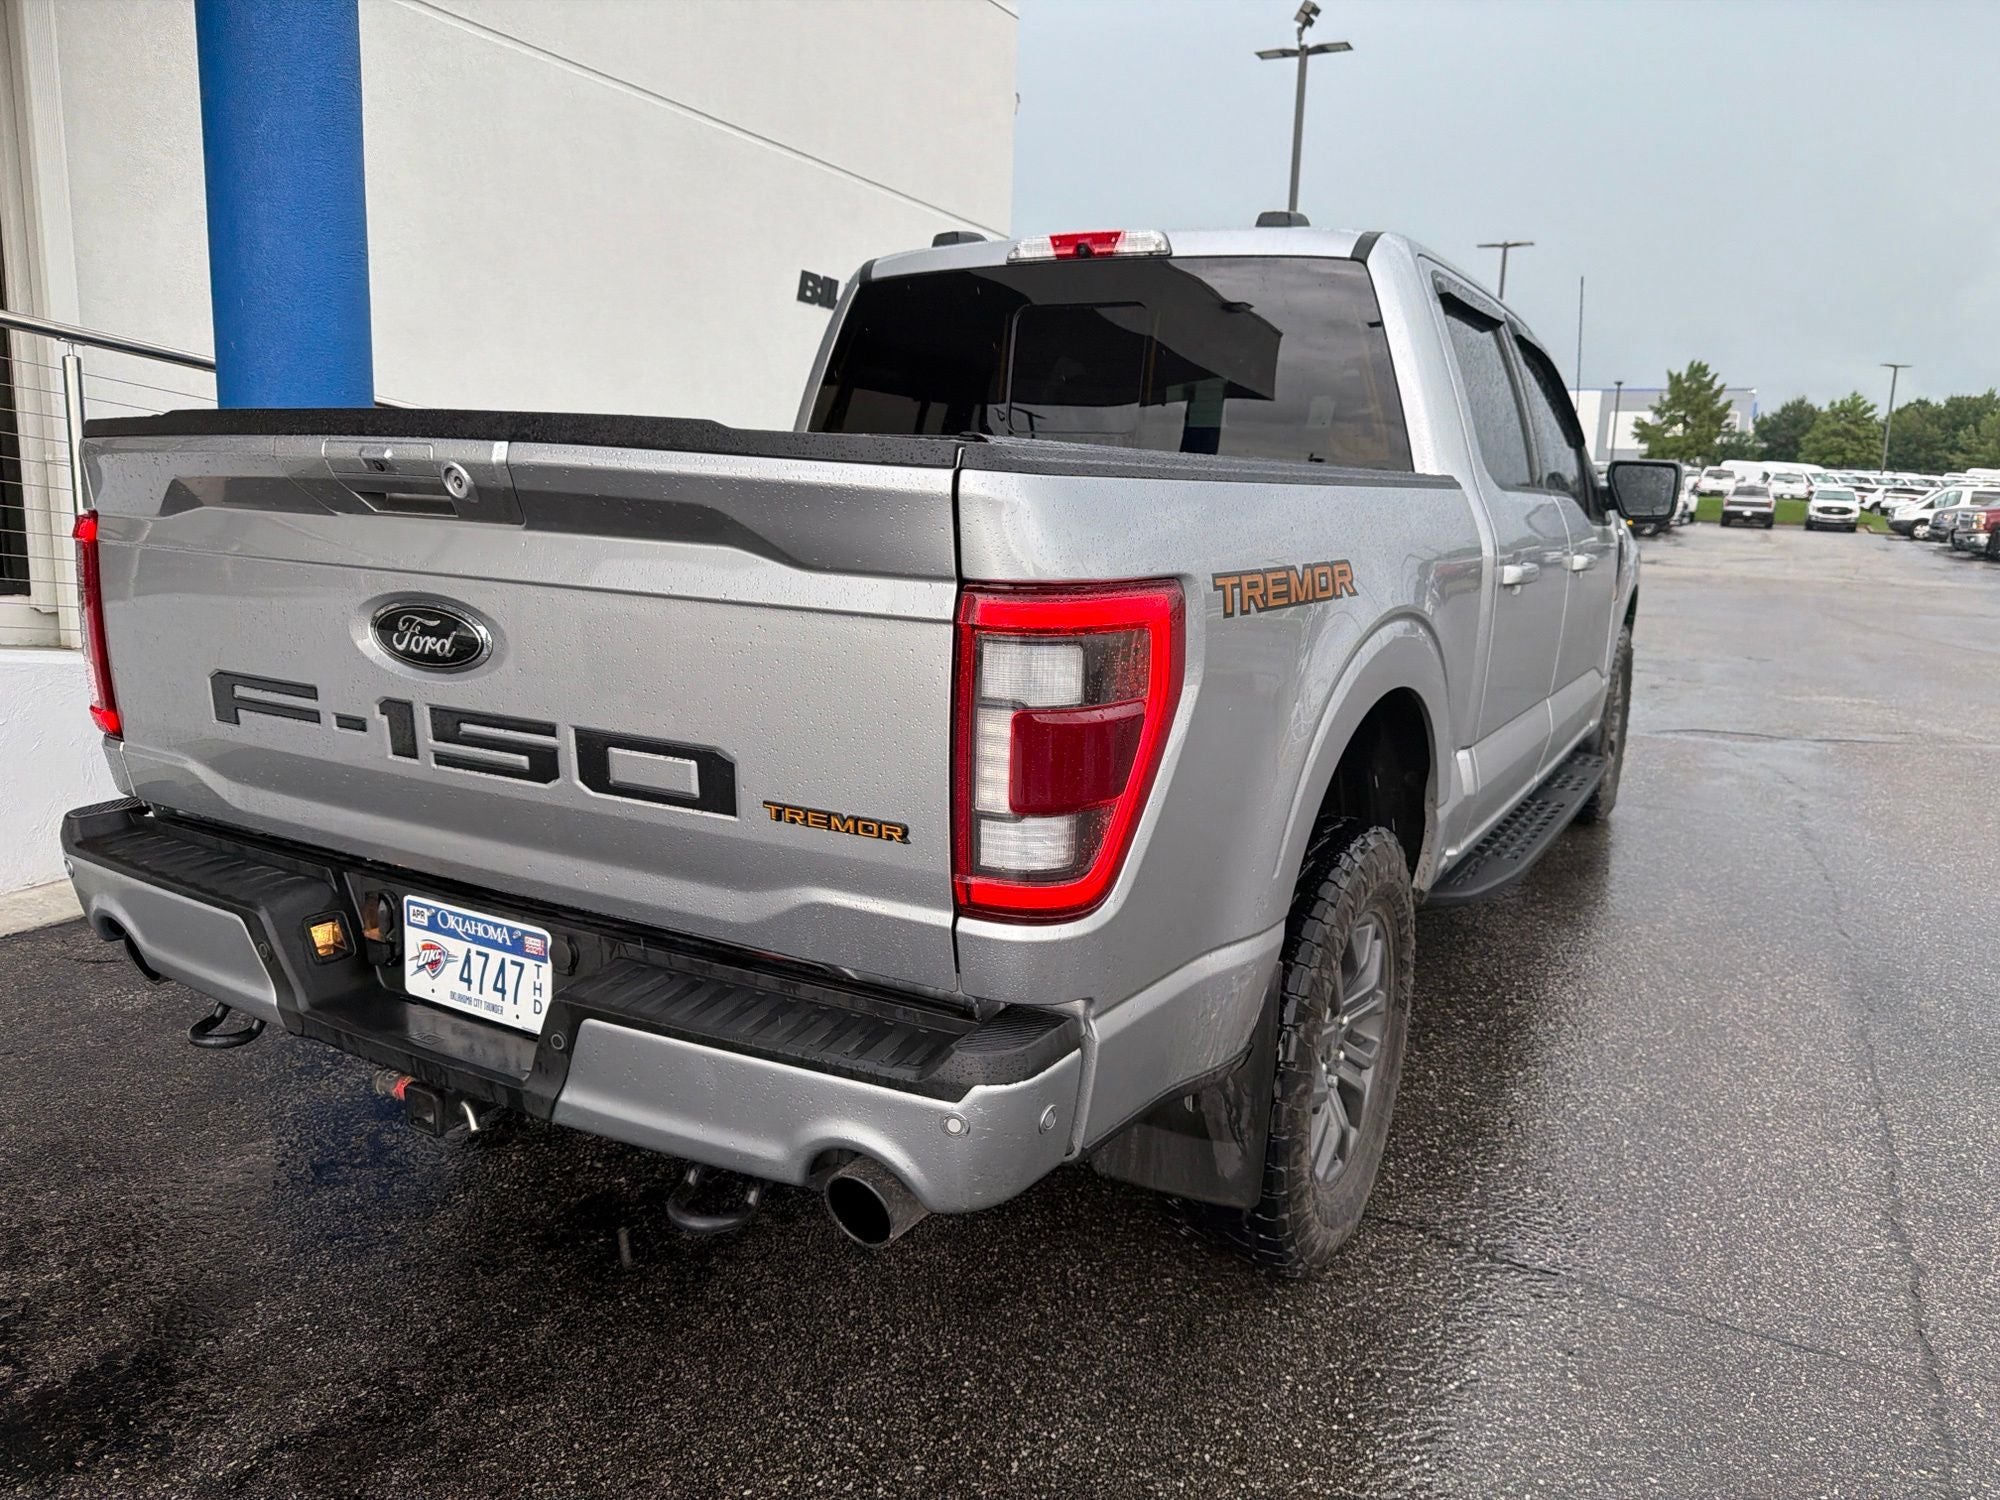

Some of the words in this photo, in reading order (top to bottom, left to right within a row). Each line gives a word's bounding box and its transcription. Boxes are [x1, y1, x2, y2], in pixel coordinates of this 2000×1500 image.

[1211, 559, 1359, 619] TREMOR
[392, 615, 457, 658] Ford
[210, 669, 739, 820] F-150
[763, 800, 911, 844] TREMOR
[411, 908, 426, 920] APR
[437, 910, 512, 946] OKLAHOMA
[459, 948, 525, 1005] 4747
